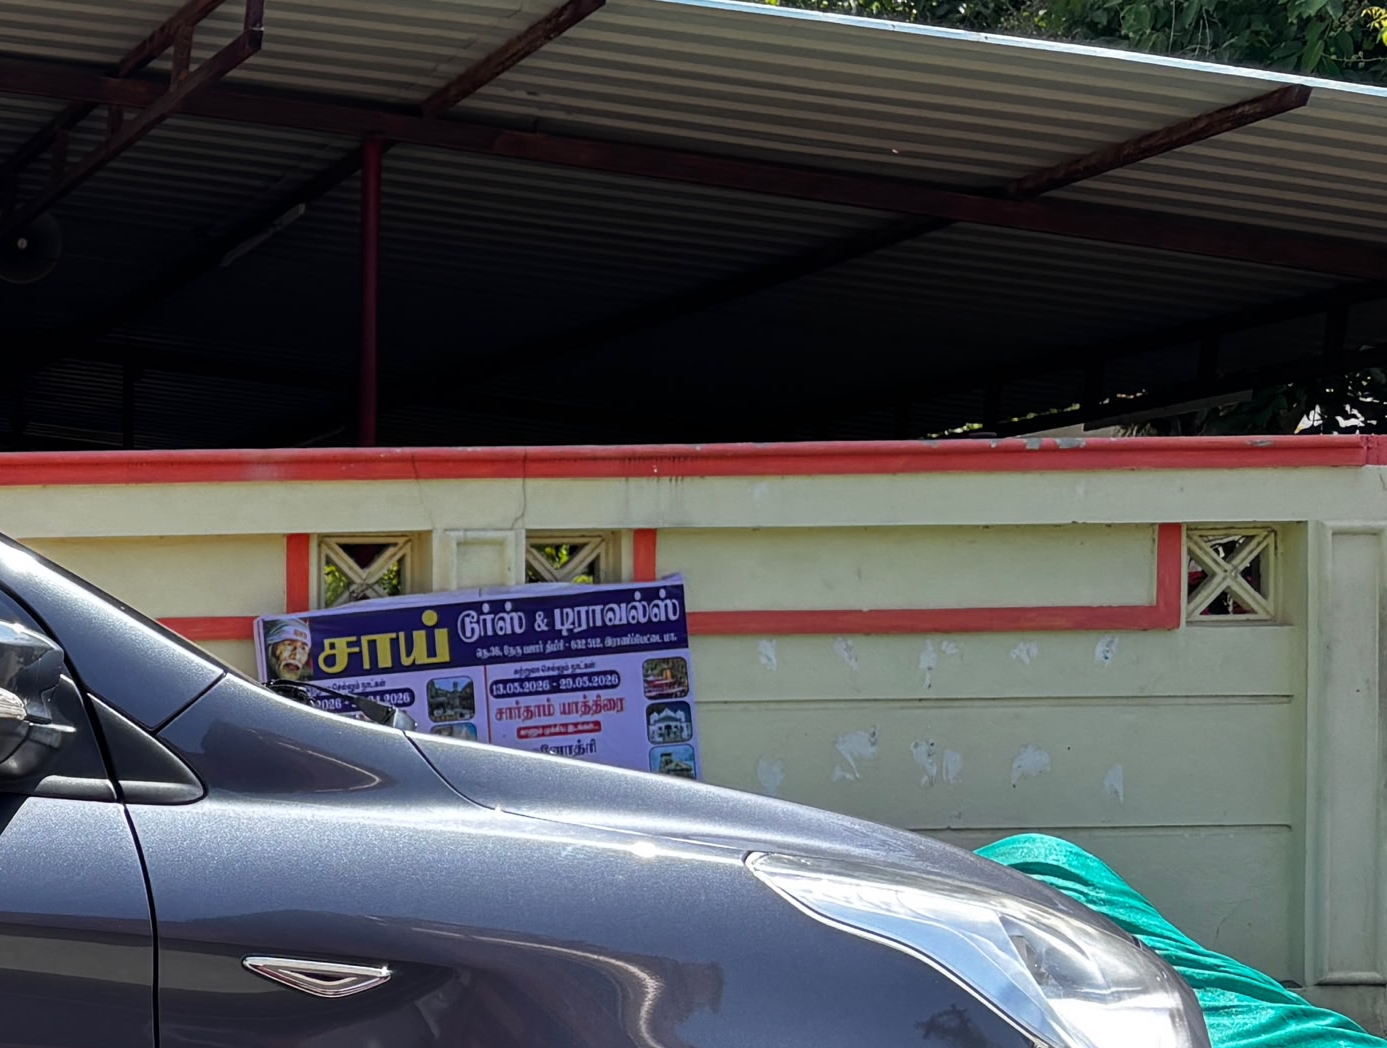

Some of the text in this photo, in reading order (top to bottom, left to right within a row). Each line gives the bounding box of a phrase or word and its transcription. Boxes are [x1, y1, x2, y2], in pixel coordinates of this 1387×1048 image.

[318, 589, 679, 674] சாய் டூர்ஸ் & டிராவல்ஸ்
[492, 681, 550, 696] 13.05.2026
[559, 674, 619, 690] 29.05.2026
[495, 693, 626, 722] சார்தாம் யாத்திரை
